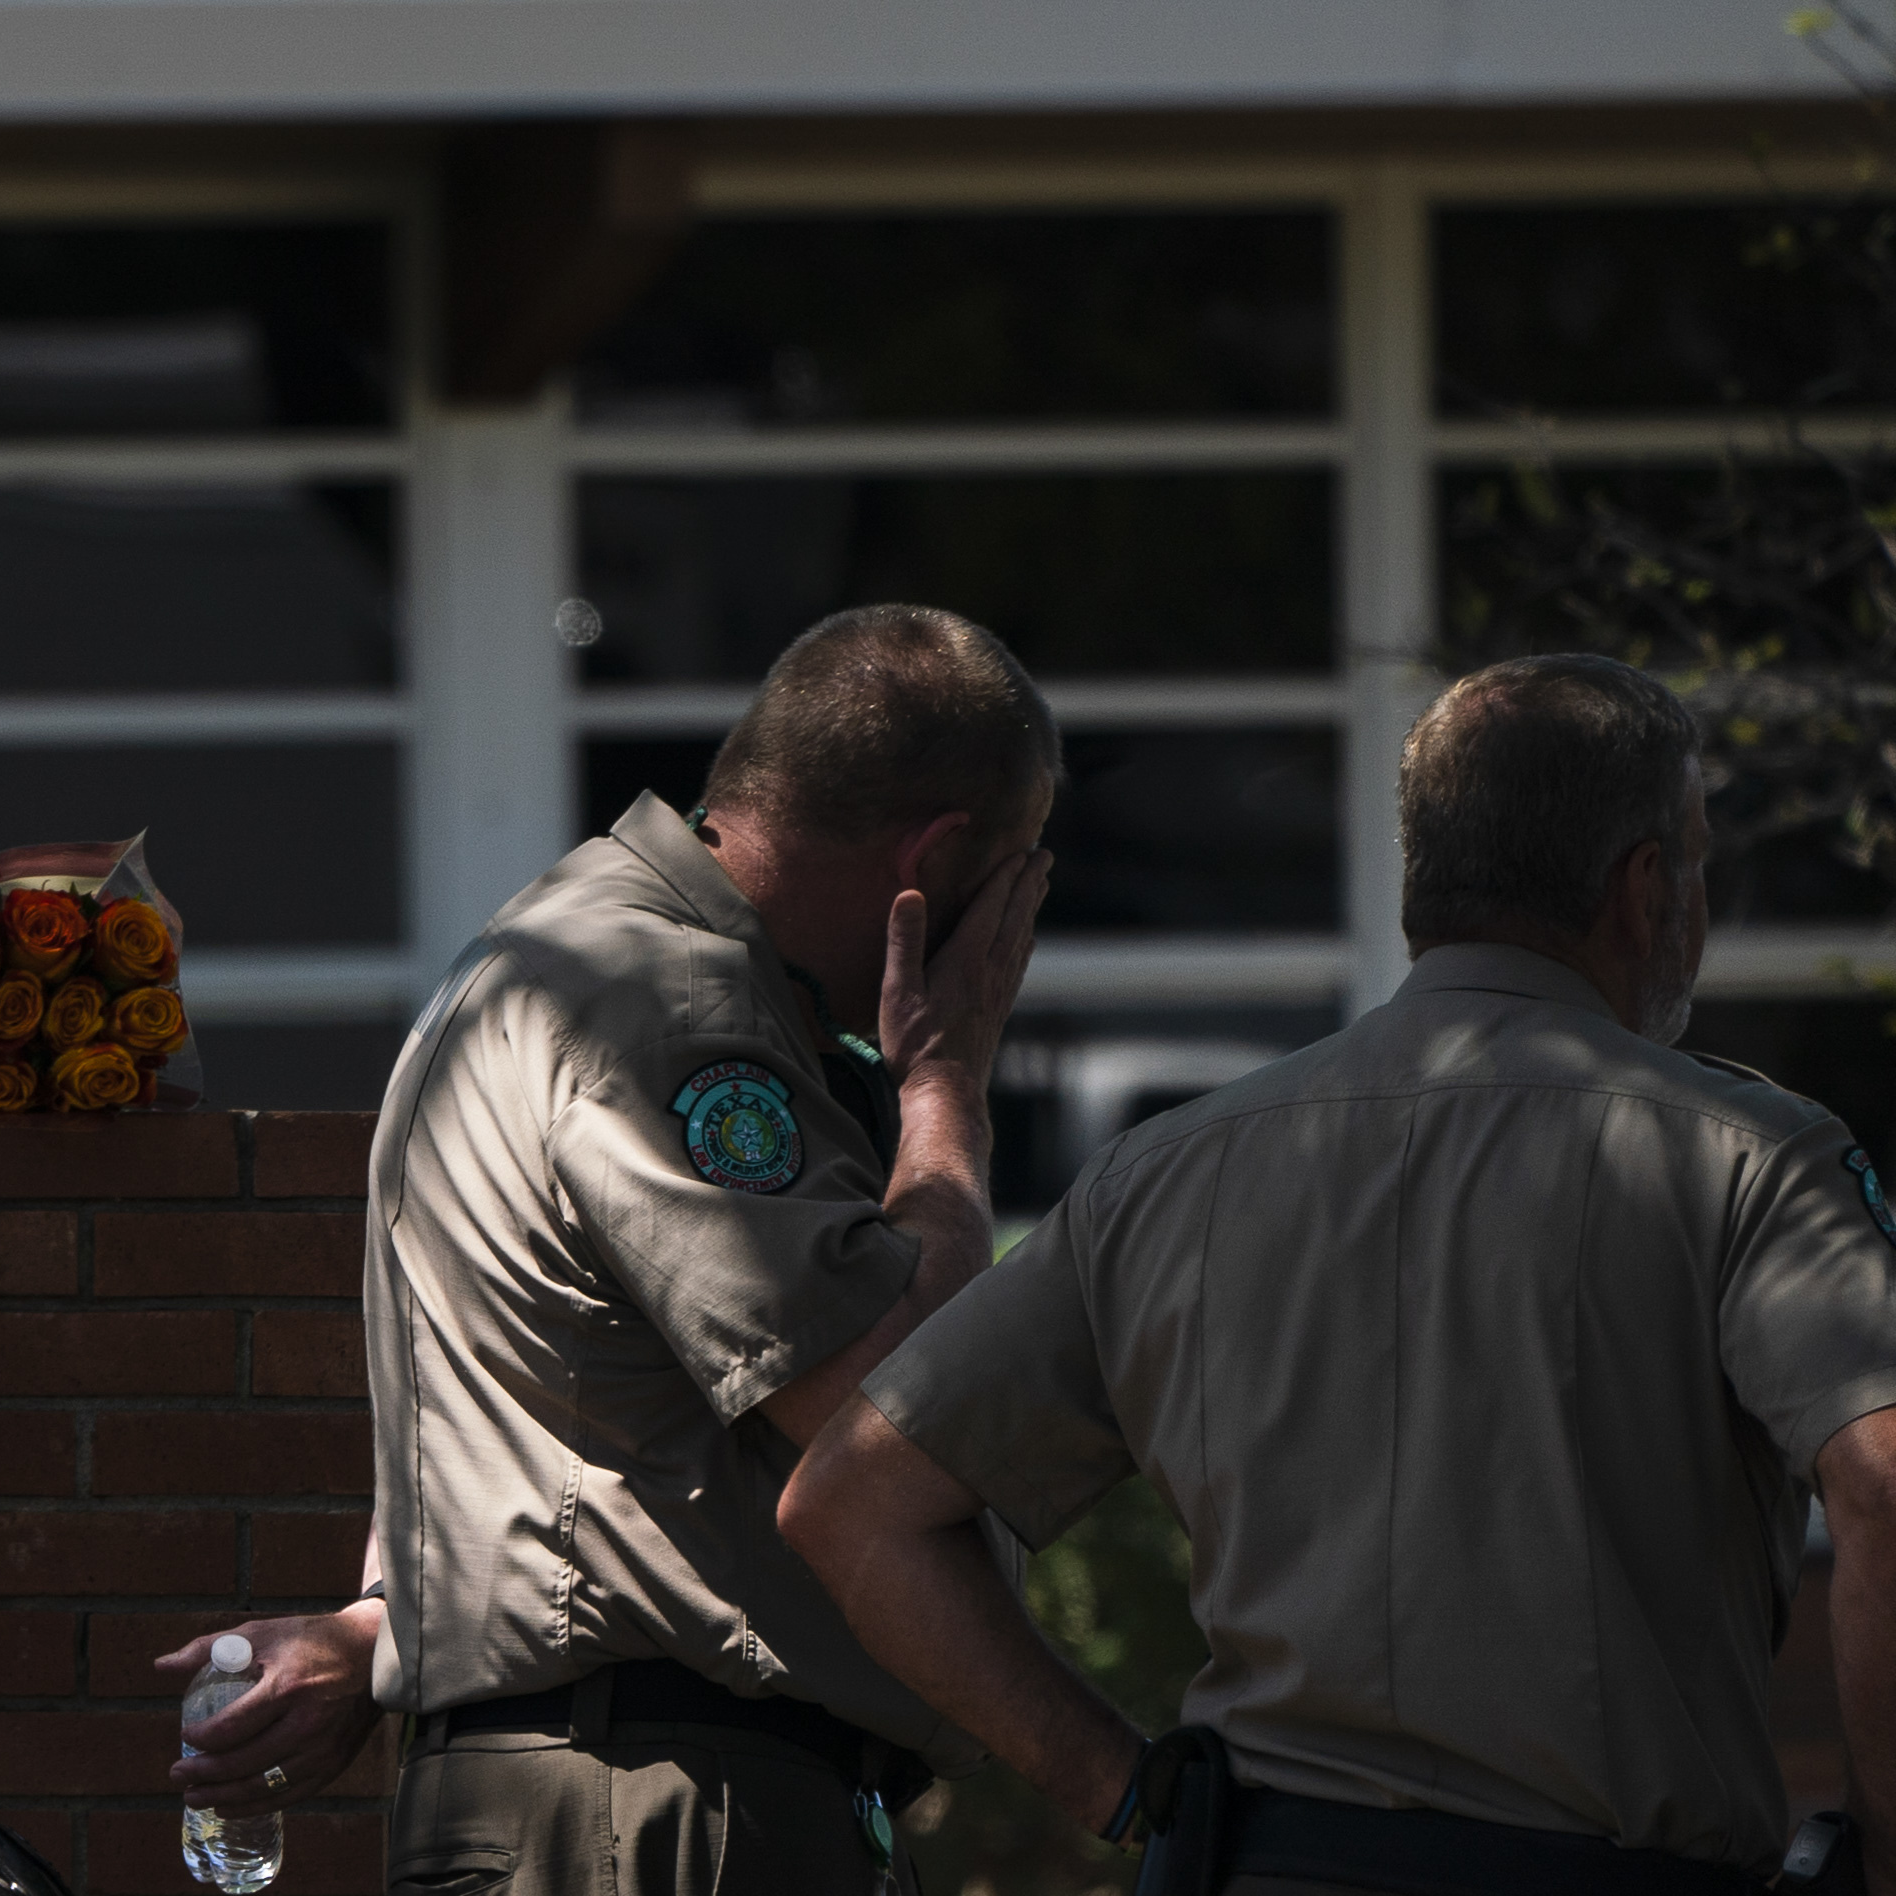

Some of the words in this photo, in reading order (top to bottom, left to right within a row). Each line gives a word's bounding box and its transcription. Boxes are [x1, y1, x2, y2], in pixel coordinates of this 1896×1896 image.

[690, 1063, 770, 1092] CHAPLAIN
[706, 1095, 780, 1128] TEXAS
[691, 1143, 711, 1168] LAW
[709, 1168, 789, 1193] ENFORCEMENT
